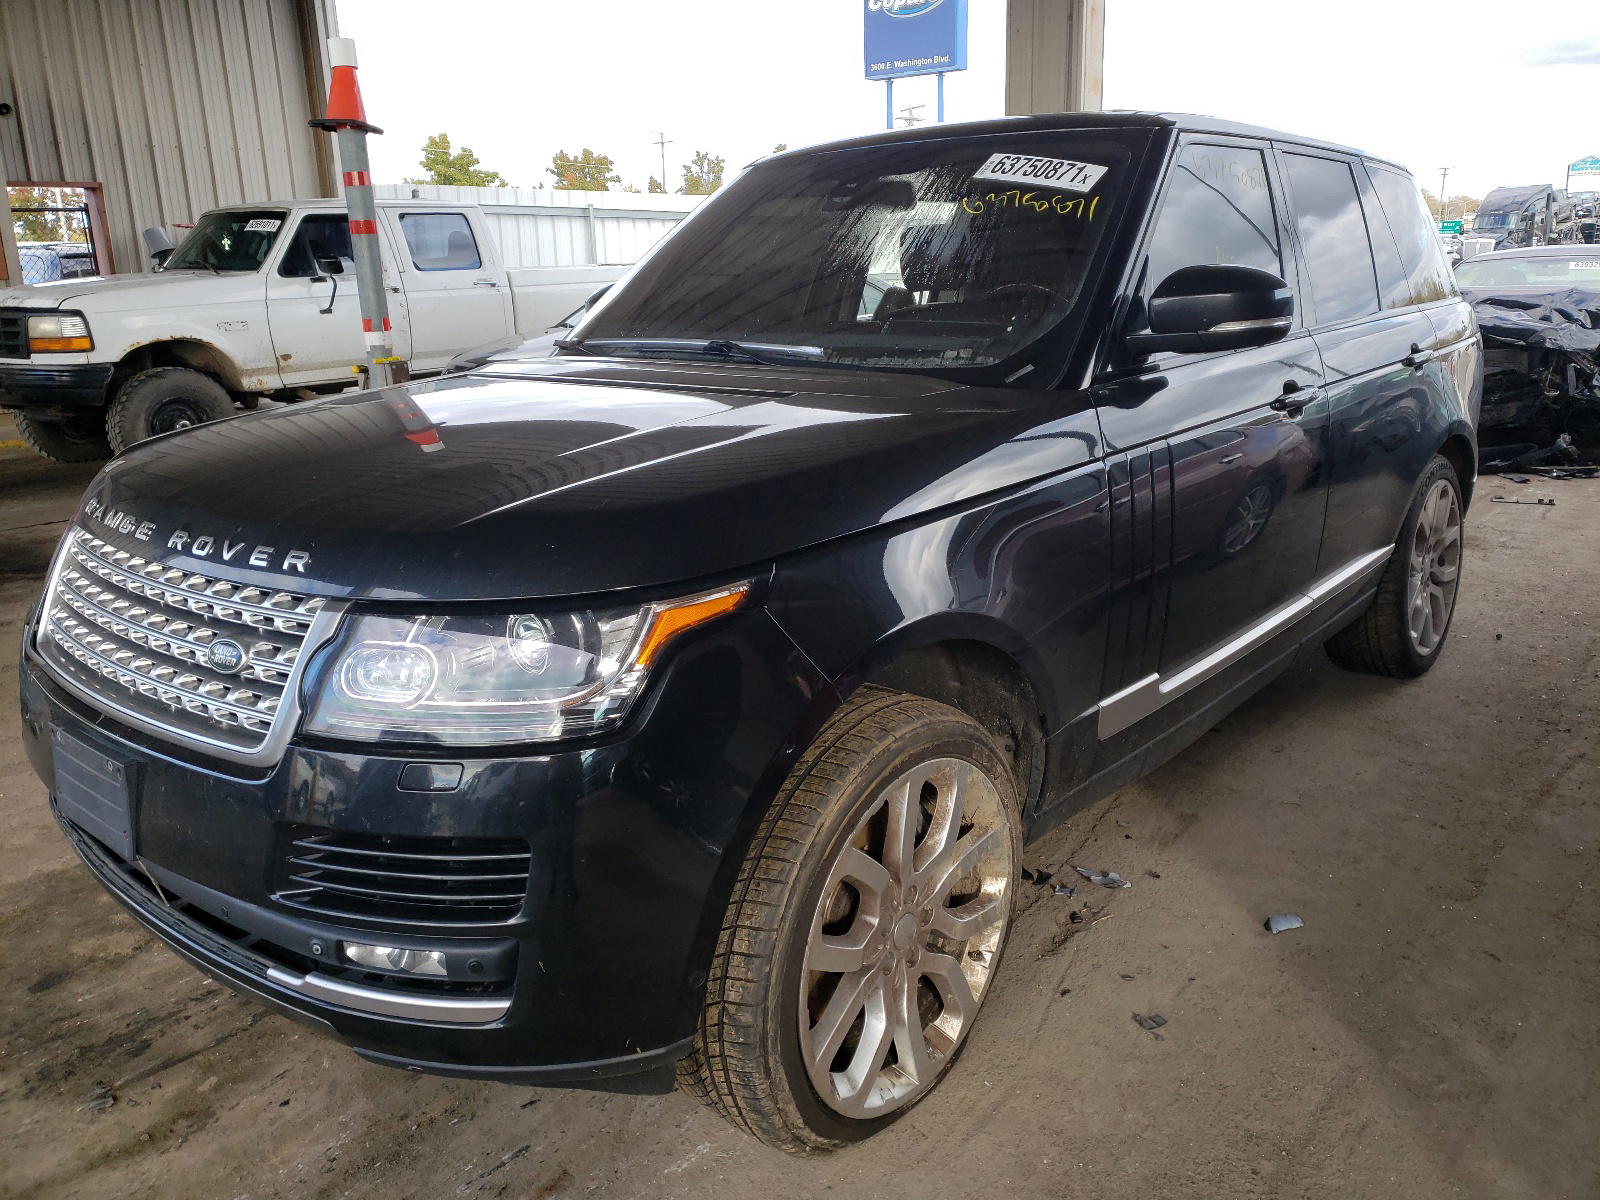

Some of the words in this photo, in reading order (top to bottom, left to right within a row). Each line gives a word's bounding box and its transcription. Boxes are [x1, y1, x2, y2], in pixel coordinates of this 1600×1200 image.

[870, 63, 885, 72] 3600
[894, 57, 932, 68] Washington
[933, 54, 951, 63] Blvd.
[85, 497, 156, 542] RANGE
[167, 529, 312, 573] ROVER
[214, 645, 232, 656] LAND
[213, 654, 237, 667] ROVER
